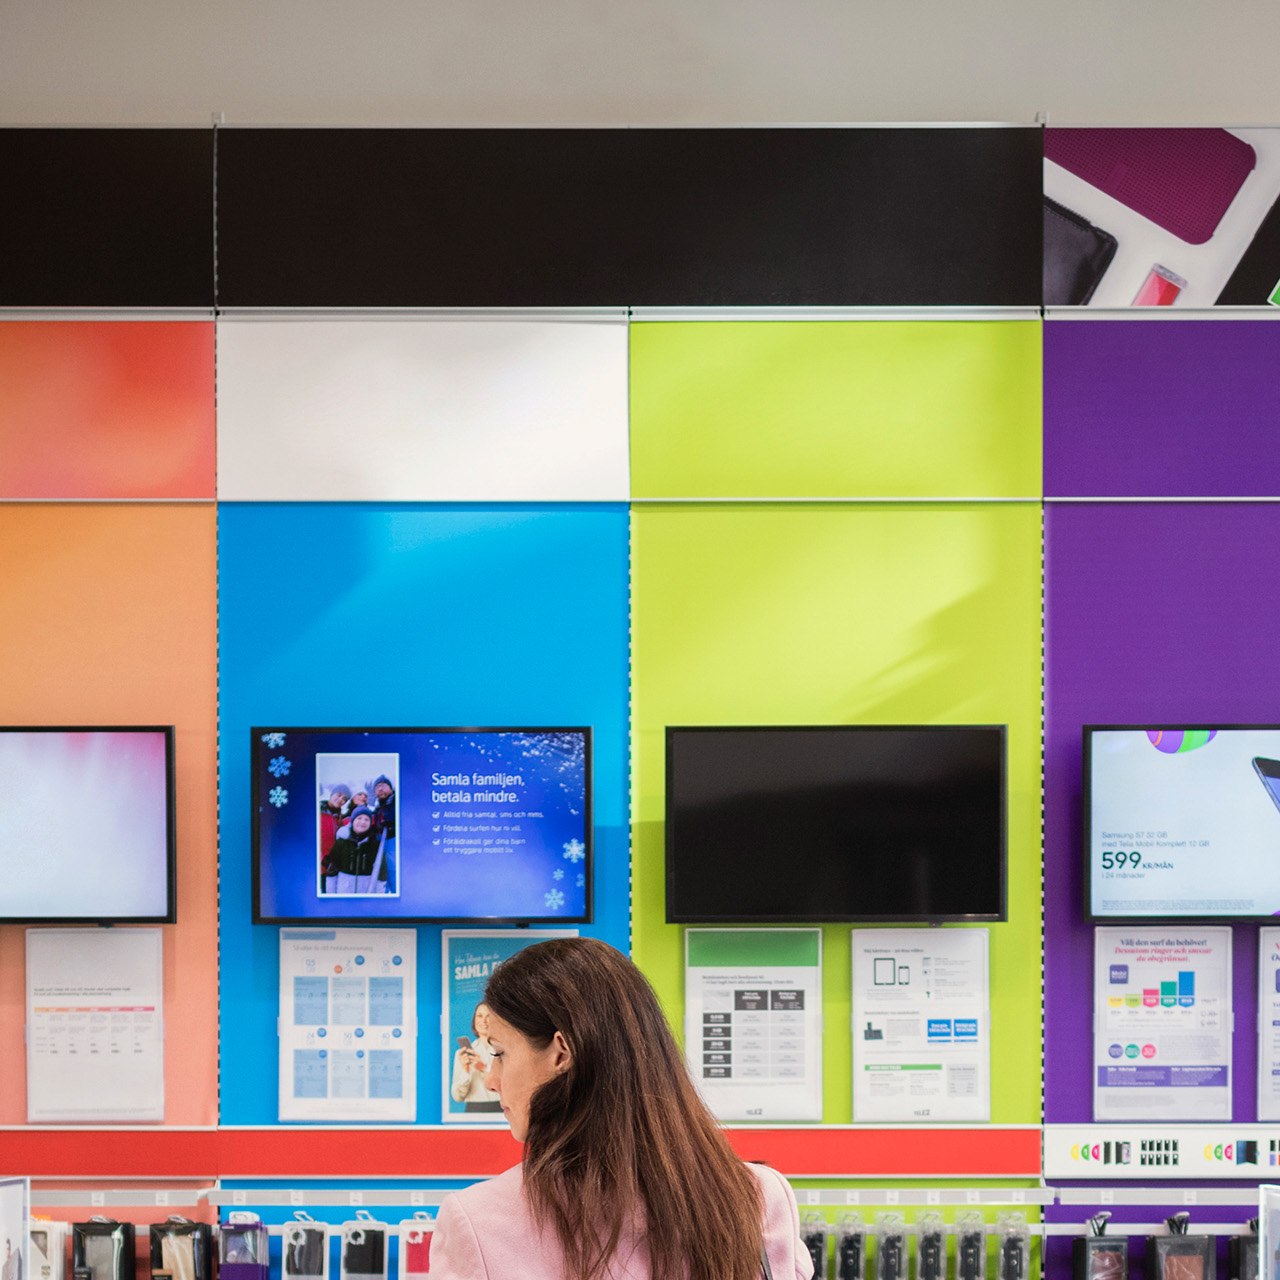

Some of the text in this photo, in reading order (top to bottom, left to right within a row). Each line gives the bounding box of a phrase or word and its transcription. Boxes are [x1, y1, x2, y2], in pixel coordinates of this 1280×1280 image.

[432, 773, 524, 788] Samla familjen,
[432, 791, 518, 802] betala mindre.
[1102, 851, 1142, 868] 599
[455, 962, 488, 980] SAMLA
